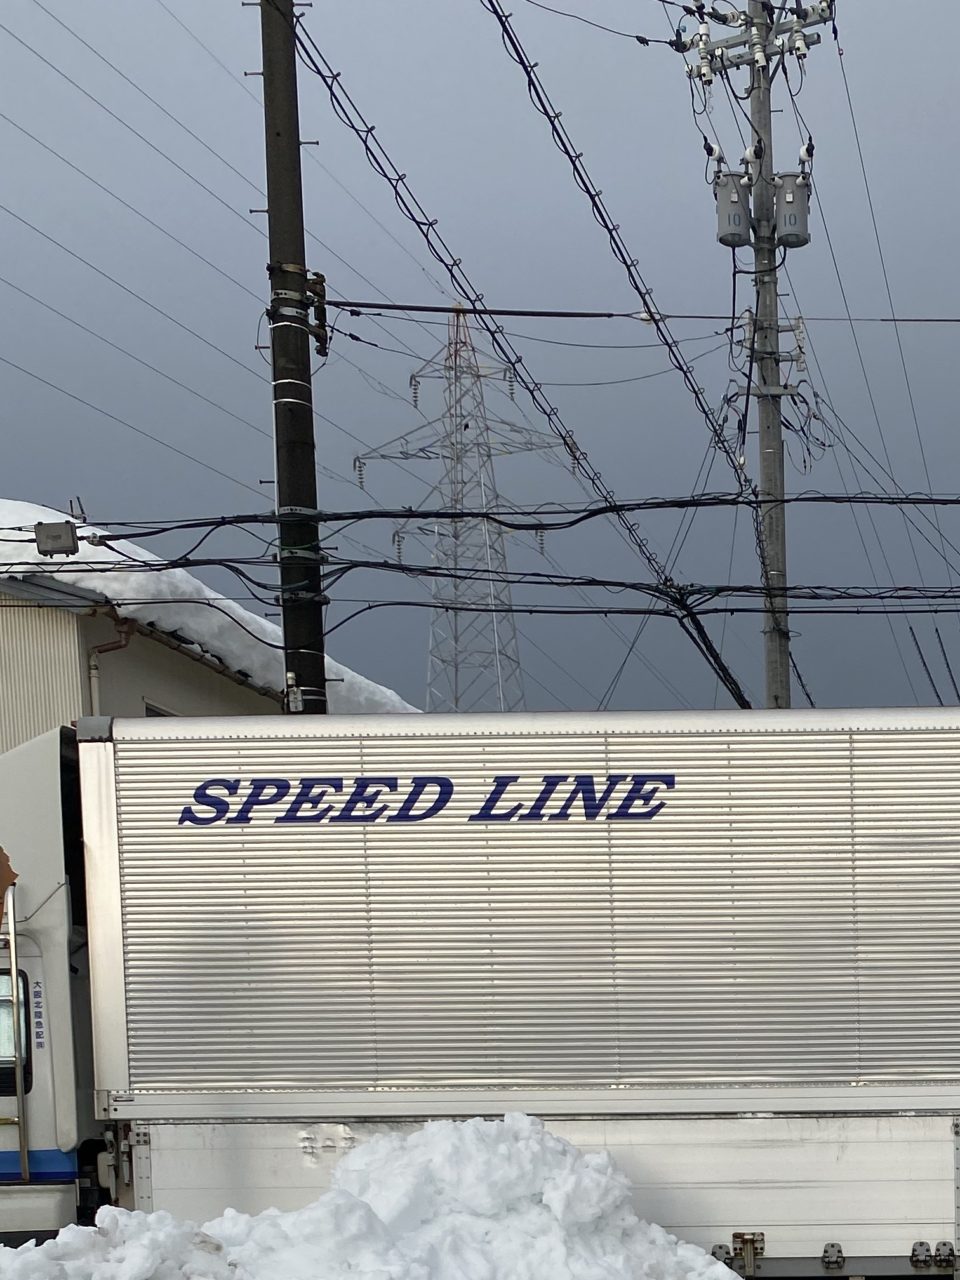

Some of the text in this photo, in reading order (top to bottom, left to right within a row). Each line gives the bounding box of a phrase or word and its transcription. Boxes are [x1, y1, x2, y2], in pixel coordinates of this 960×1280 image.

[727, 213, 741, 227] 10
[783, 213, 797, 227] 10
[178, 774, 675, 825] SPEED LINE
